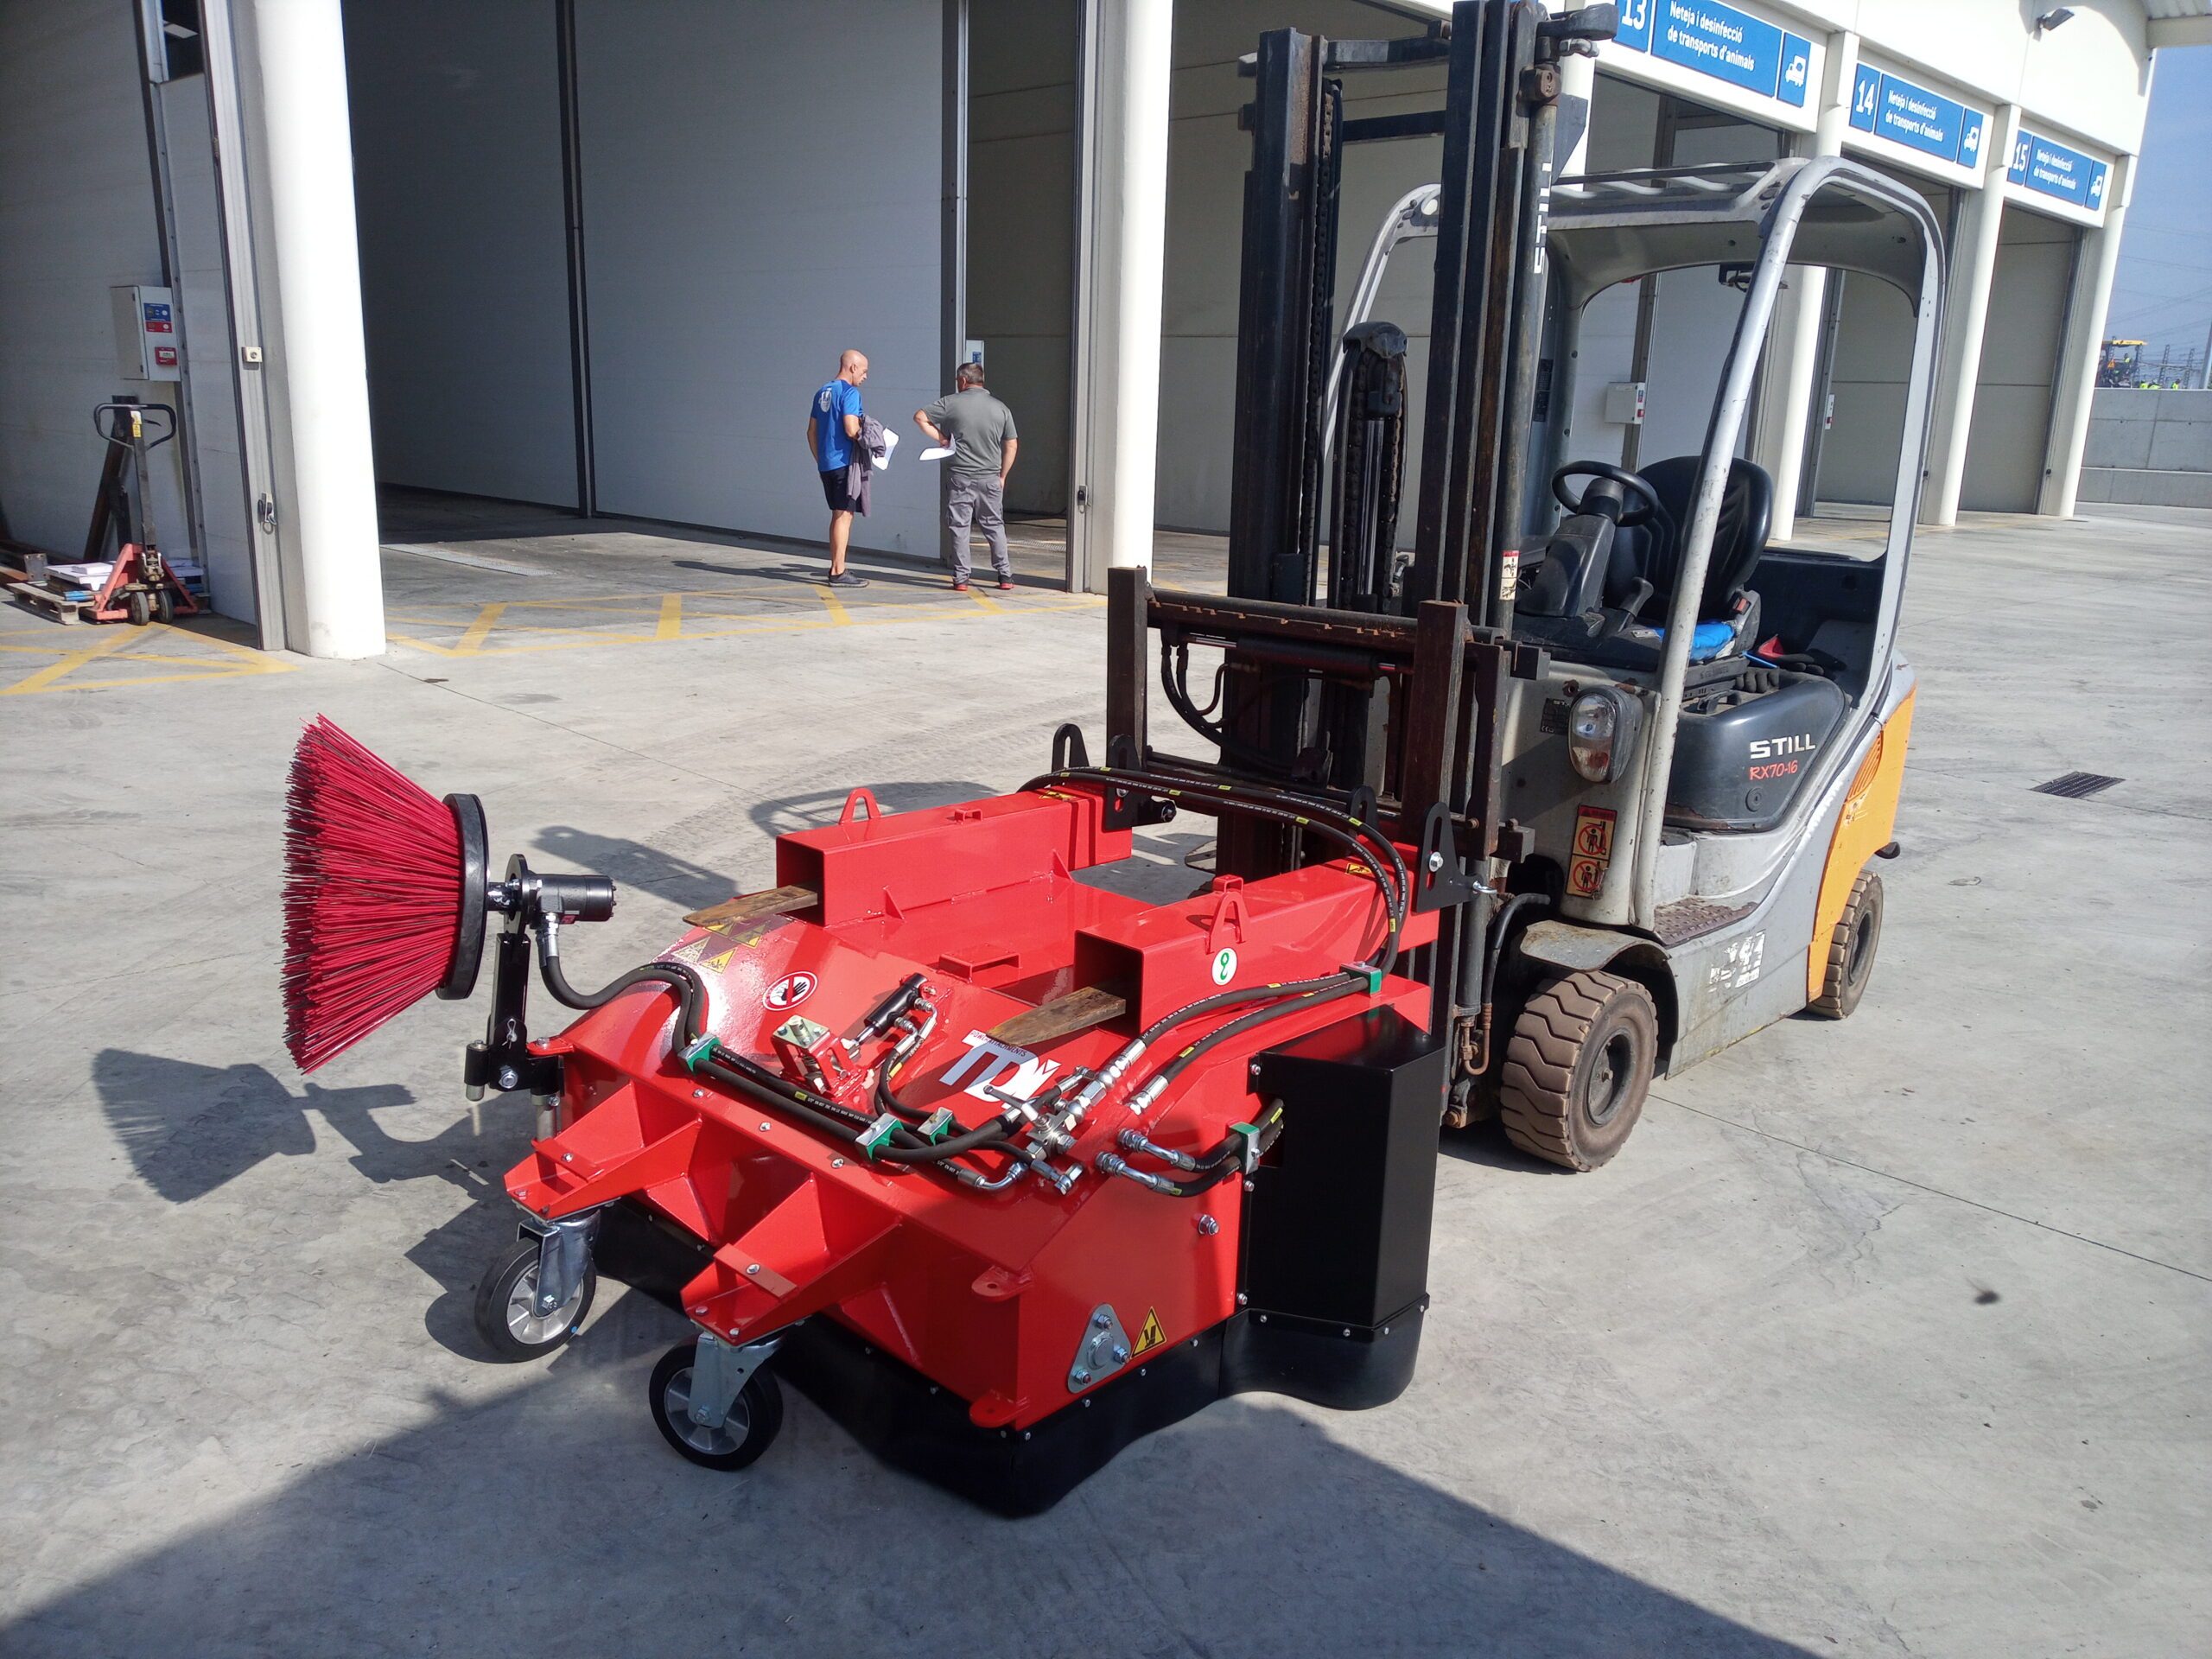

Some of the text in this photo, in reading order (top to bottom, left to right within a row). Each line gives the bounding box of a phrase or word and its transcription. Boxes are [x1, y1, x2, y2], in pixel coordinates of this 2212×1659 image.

[1669, 0, 1695, 29] Neteja
[1700, 13, 1743, 44] desinfecció
[1667, 25, 1679, 43] de
[1679, 31, 1719, 58] transports
[1855, 79, 1875, 116] 14
[1887, 89, 1904, 111] Neteja
[1885, 109, 1893, 124] de
[1893, 114, 1920, 135] transports
[2012, 143, 2029, 172] 15
[1750, 734, 1816, 760] STILL
[1749, 760, 1798, 781] RX70-16
